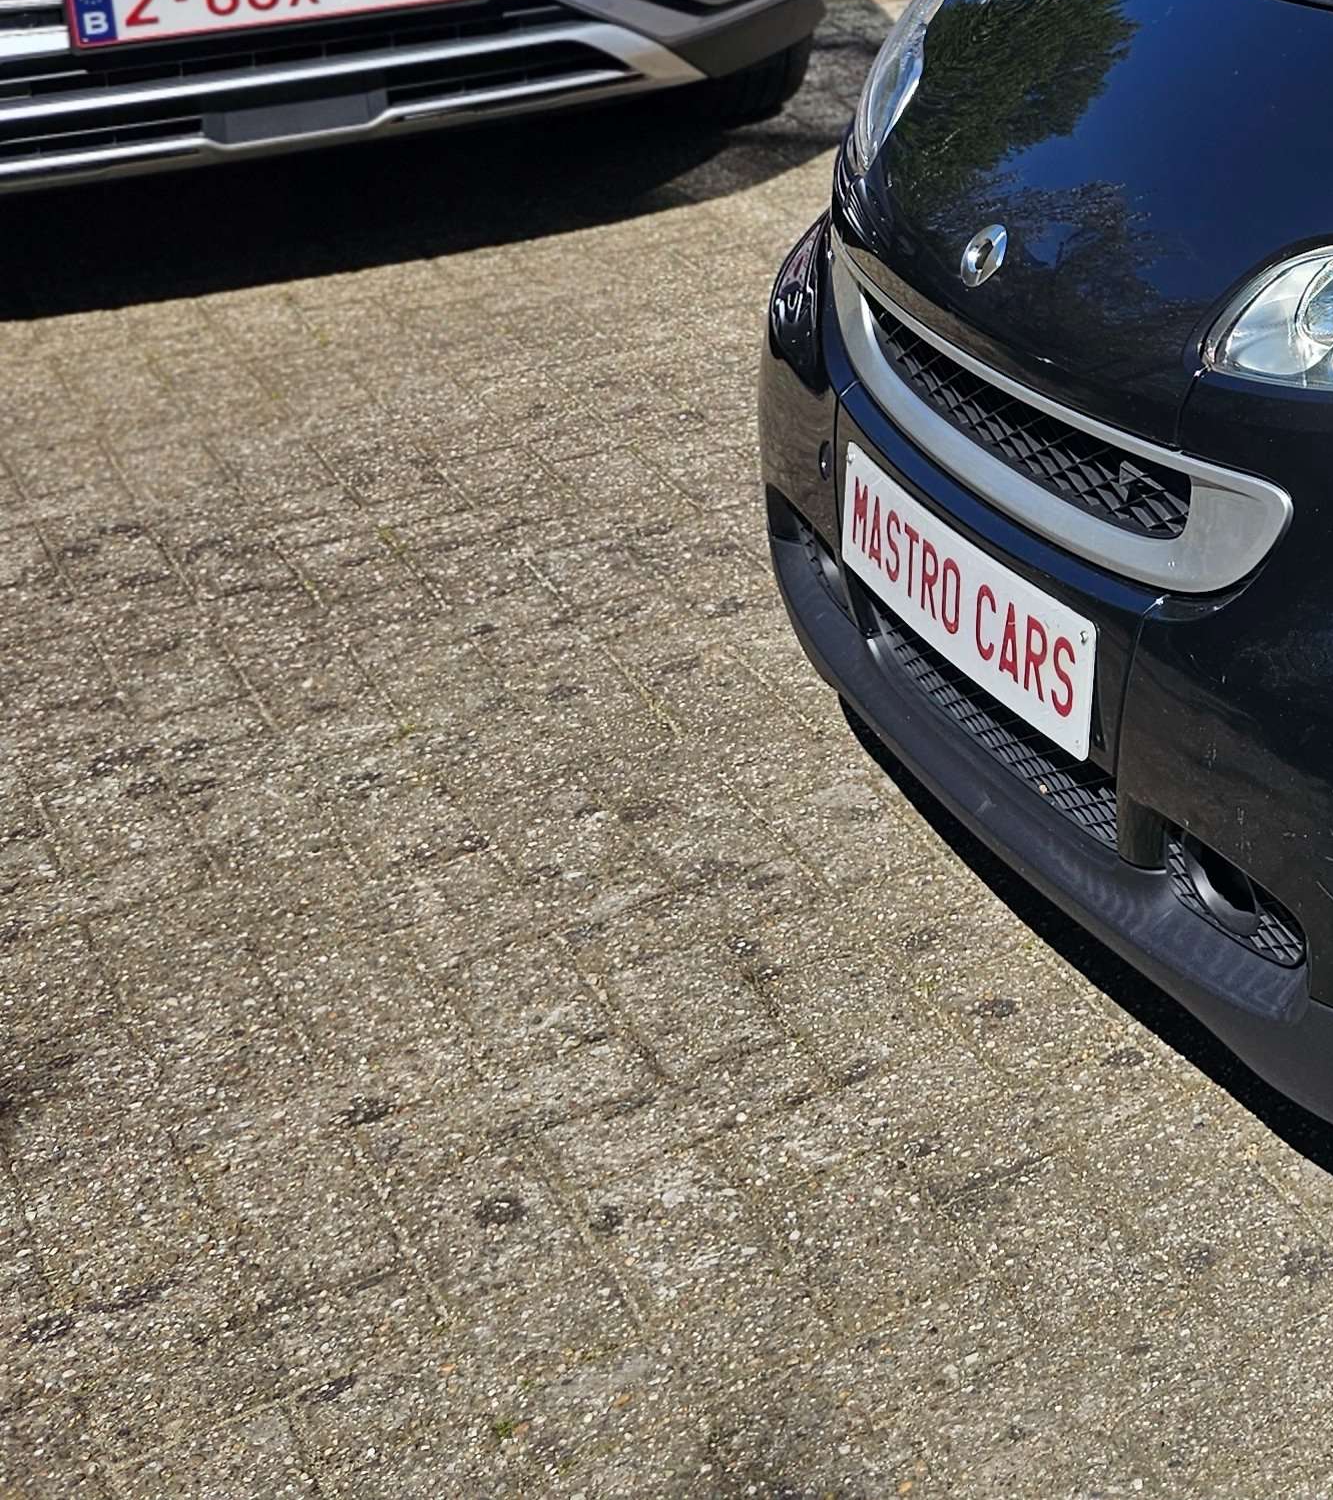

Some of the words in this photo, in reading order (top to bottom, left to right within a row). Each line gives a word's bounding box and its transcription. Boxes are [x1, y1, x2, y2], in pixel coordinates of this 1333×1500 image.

[83, 11, 109, 35] B
[853, 475, 961, 635] MASTRO
[975, 584, 1076, 718] CARS
